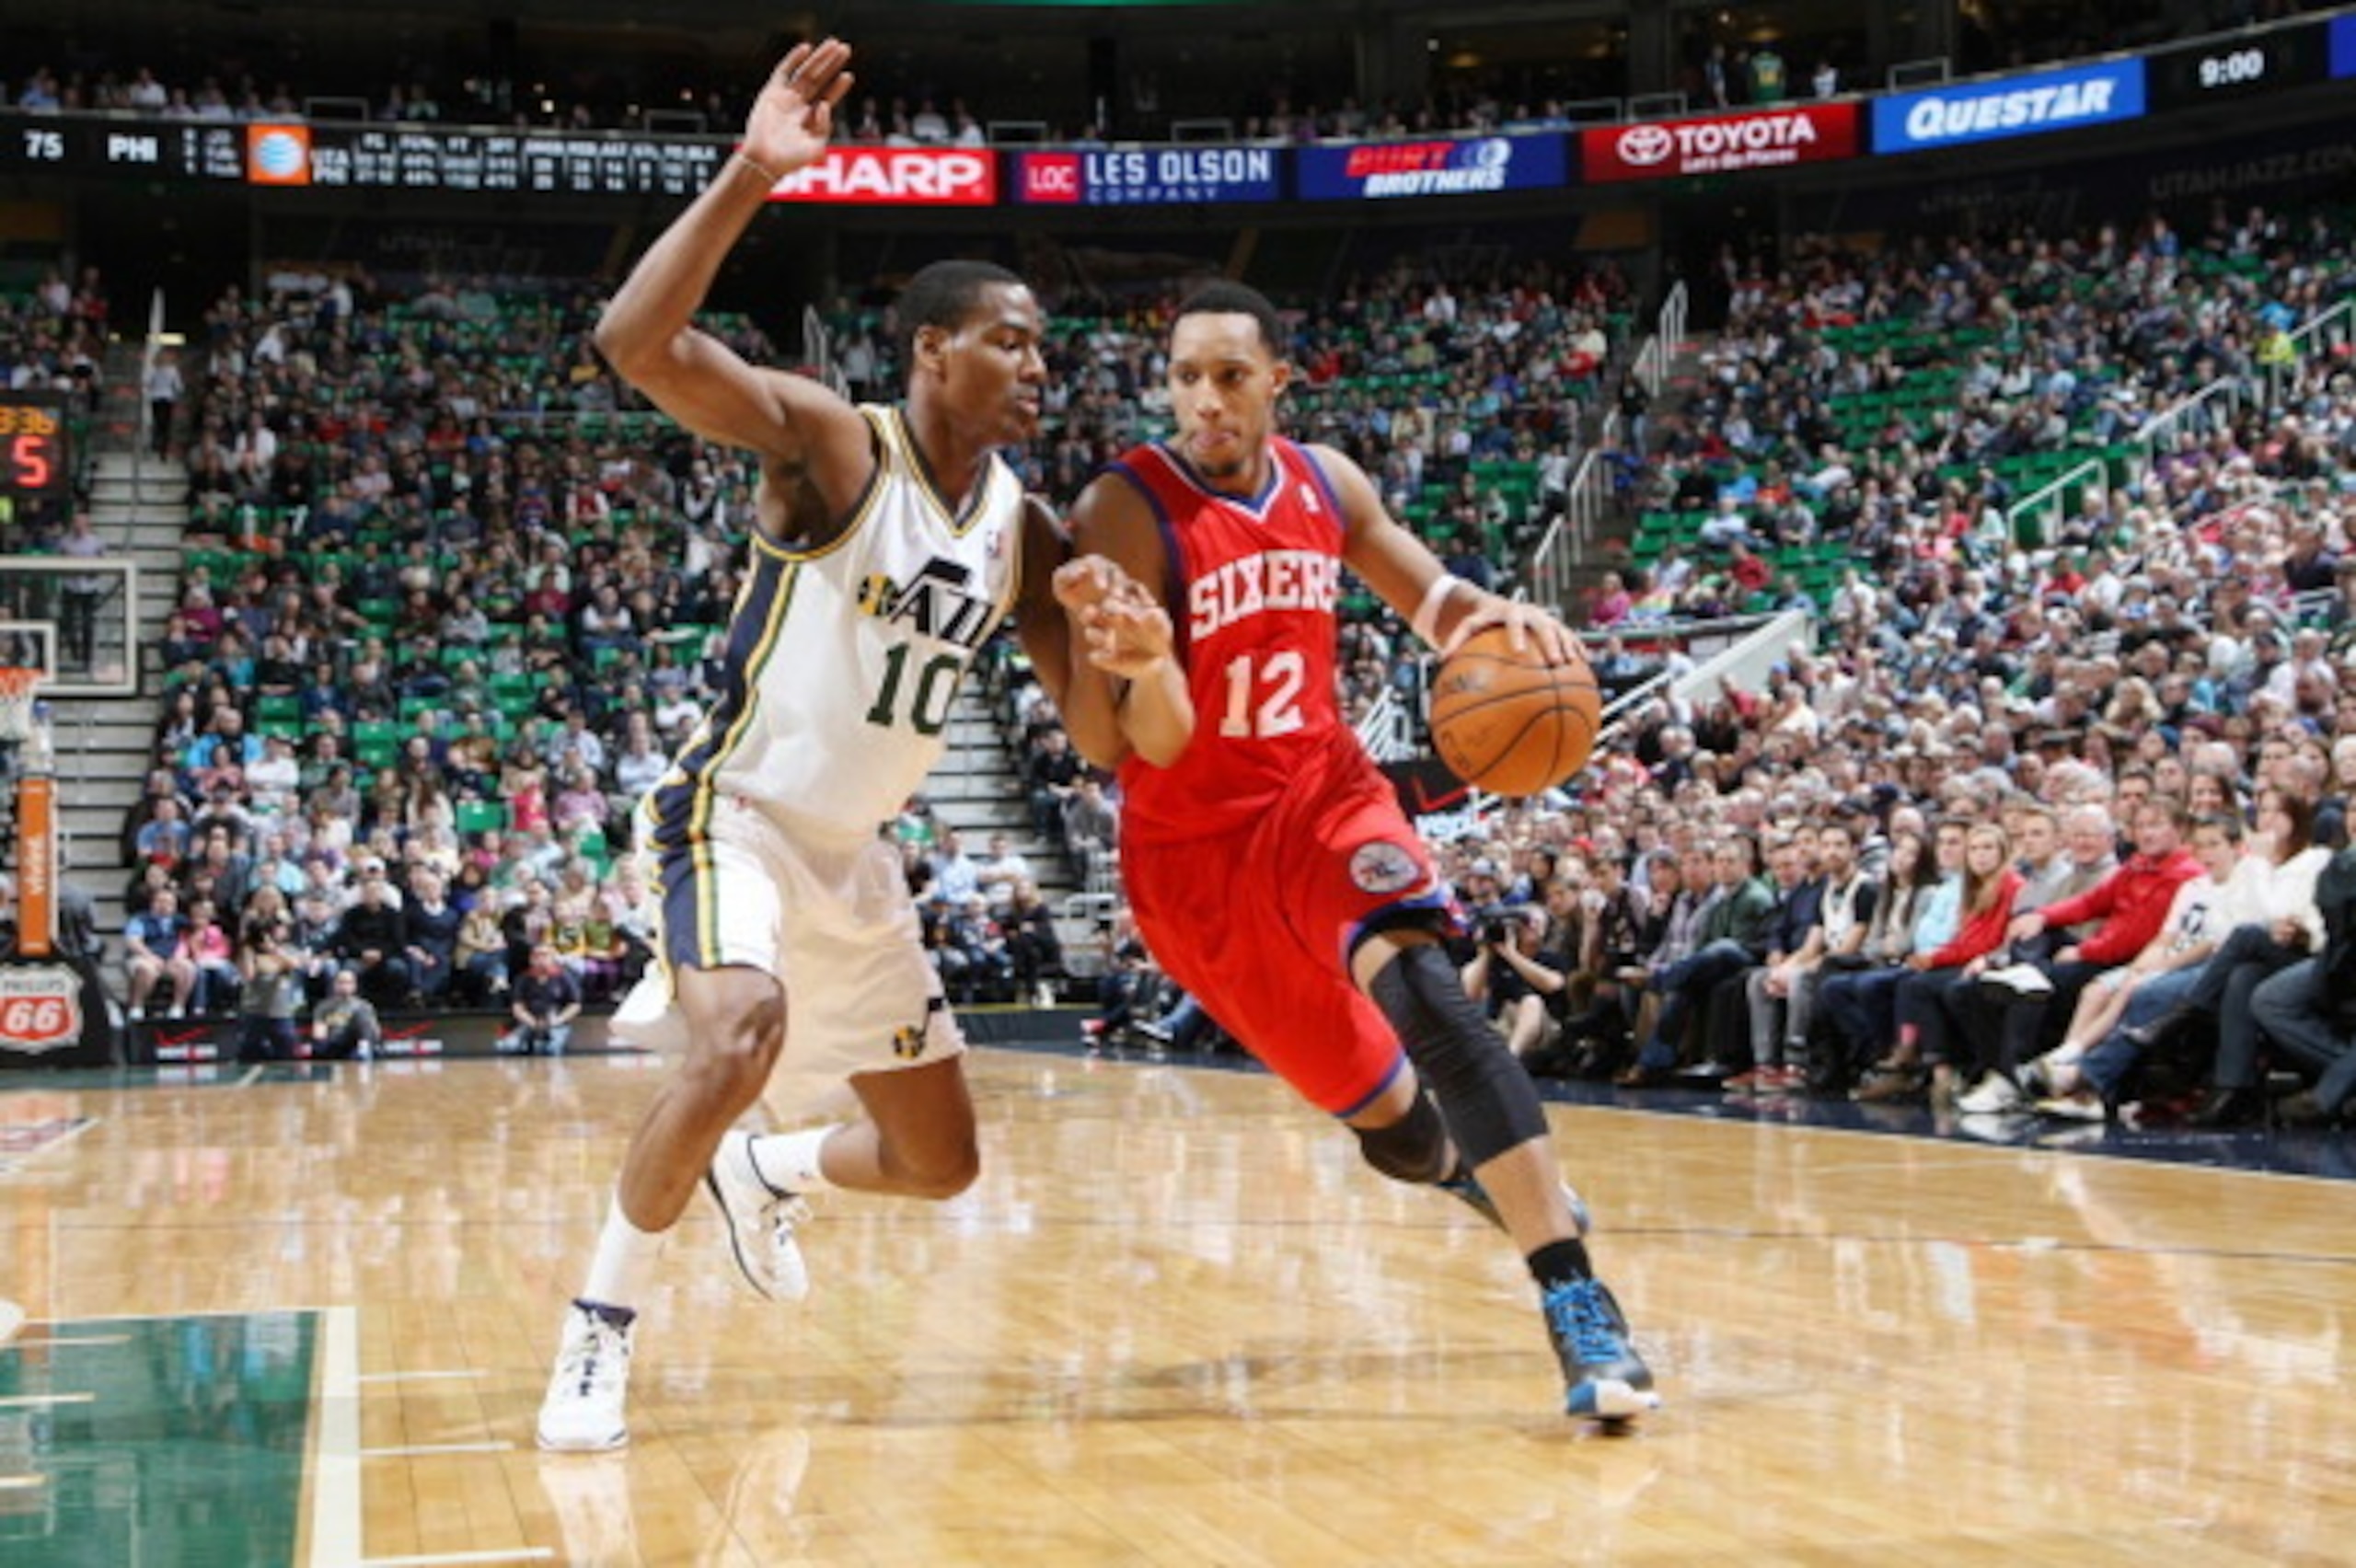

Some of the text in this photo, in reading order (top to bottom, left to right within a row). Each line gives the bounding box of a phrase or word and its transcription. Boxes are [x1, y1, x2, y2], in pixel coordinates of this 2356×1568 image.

[2200, 51, 2264, 86] 9:00
[1905, 78, 2116, 140] QUESTAR
[24, 133, 64, 160] 75
[108, 134, 158, 162] PHI
[1674, 115, 1817, 155] TOYOTA
[1026, 165, 1077, 193] LOC
[1086, 150, 1270, 185] LES OLSON
[1362, 166, 1507, 199] BROTHERS
[1088, 186, 1218, 205] COMPANY
[13, 435, 47, 488] 5
[866, 642, 962, 735] 10
[1218, 651, 1305, 739] 12
[5, 999, 62, 1033] 66
